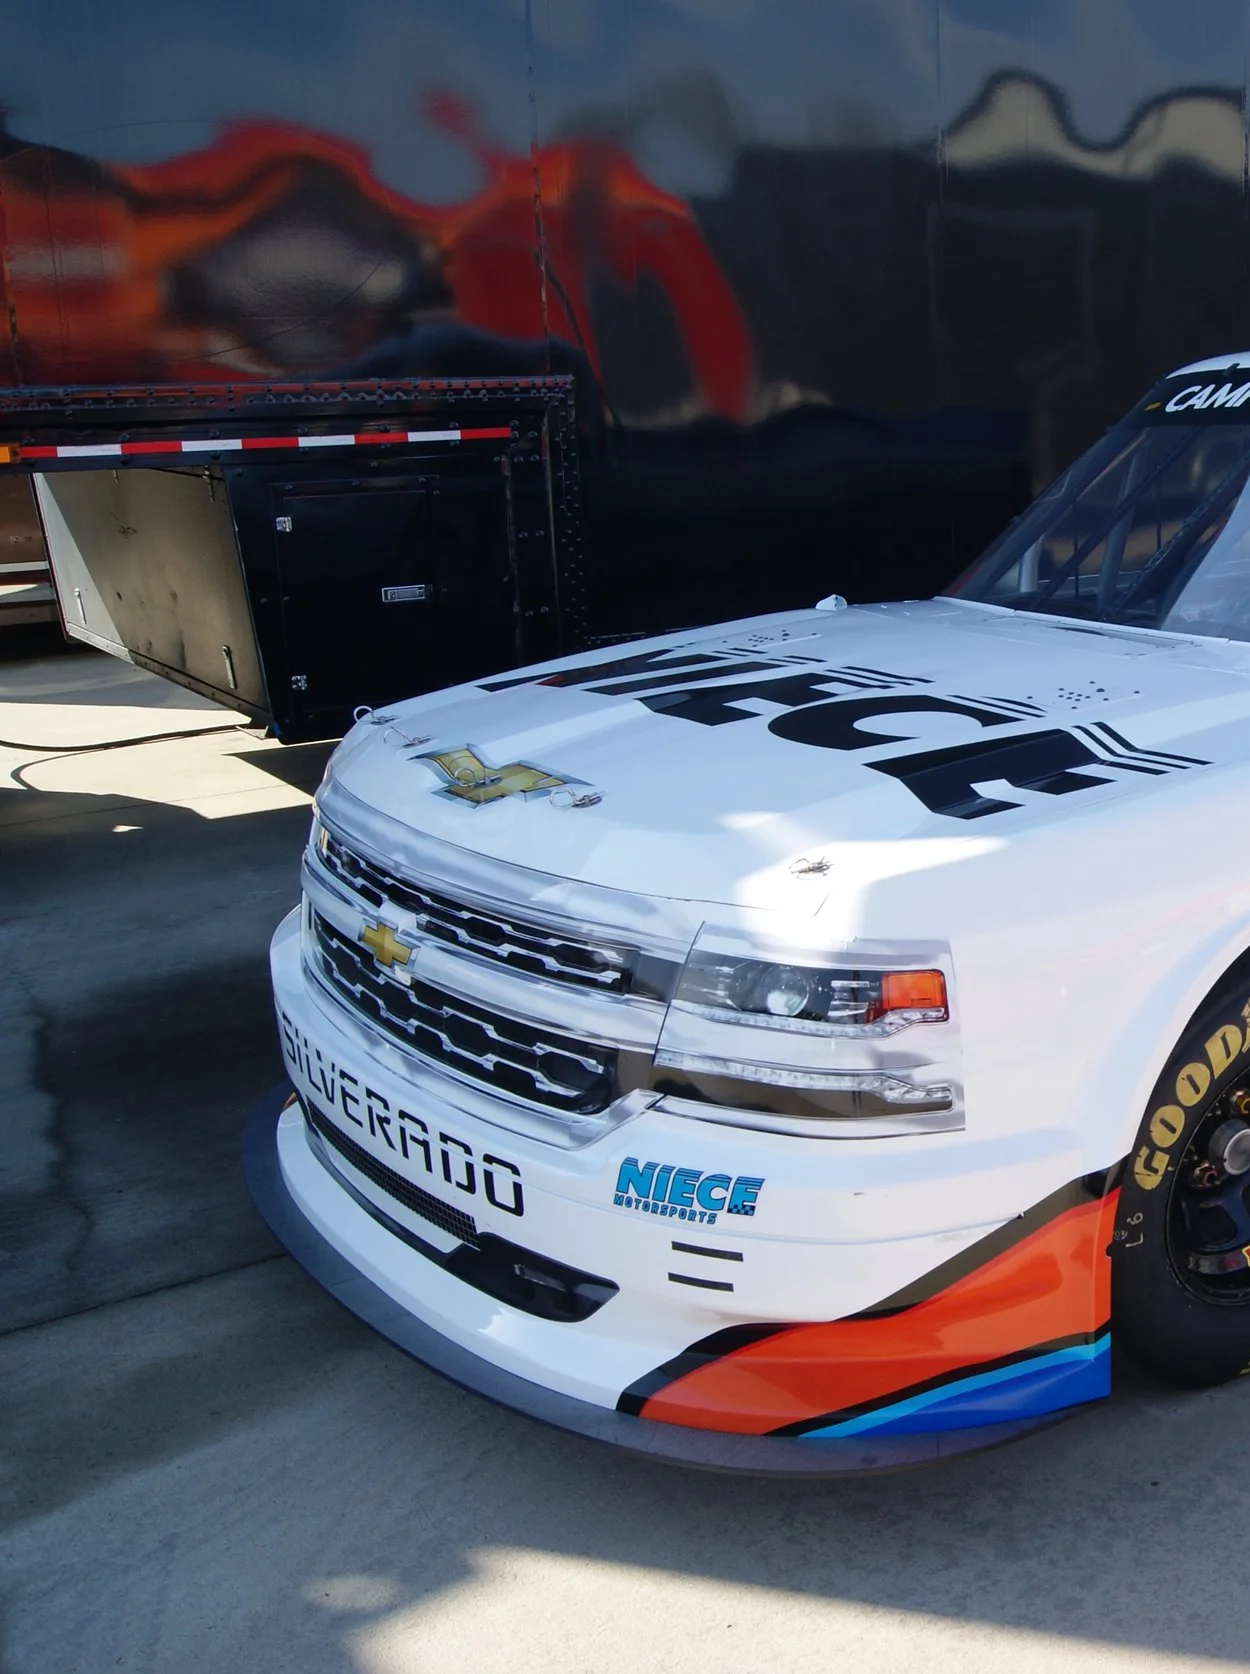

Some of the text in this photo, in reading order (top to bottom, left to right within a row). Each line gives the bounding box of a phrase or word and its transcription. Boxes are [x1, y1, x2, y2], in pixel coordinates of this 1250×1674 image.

[281, 1011, 525, 1218] SILVERADO
[613, 1193, 718, 1226] MOTORSPORTS
[615, 1156, 766, 1217] NIECE
